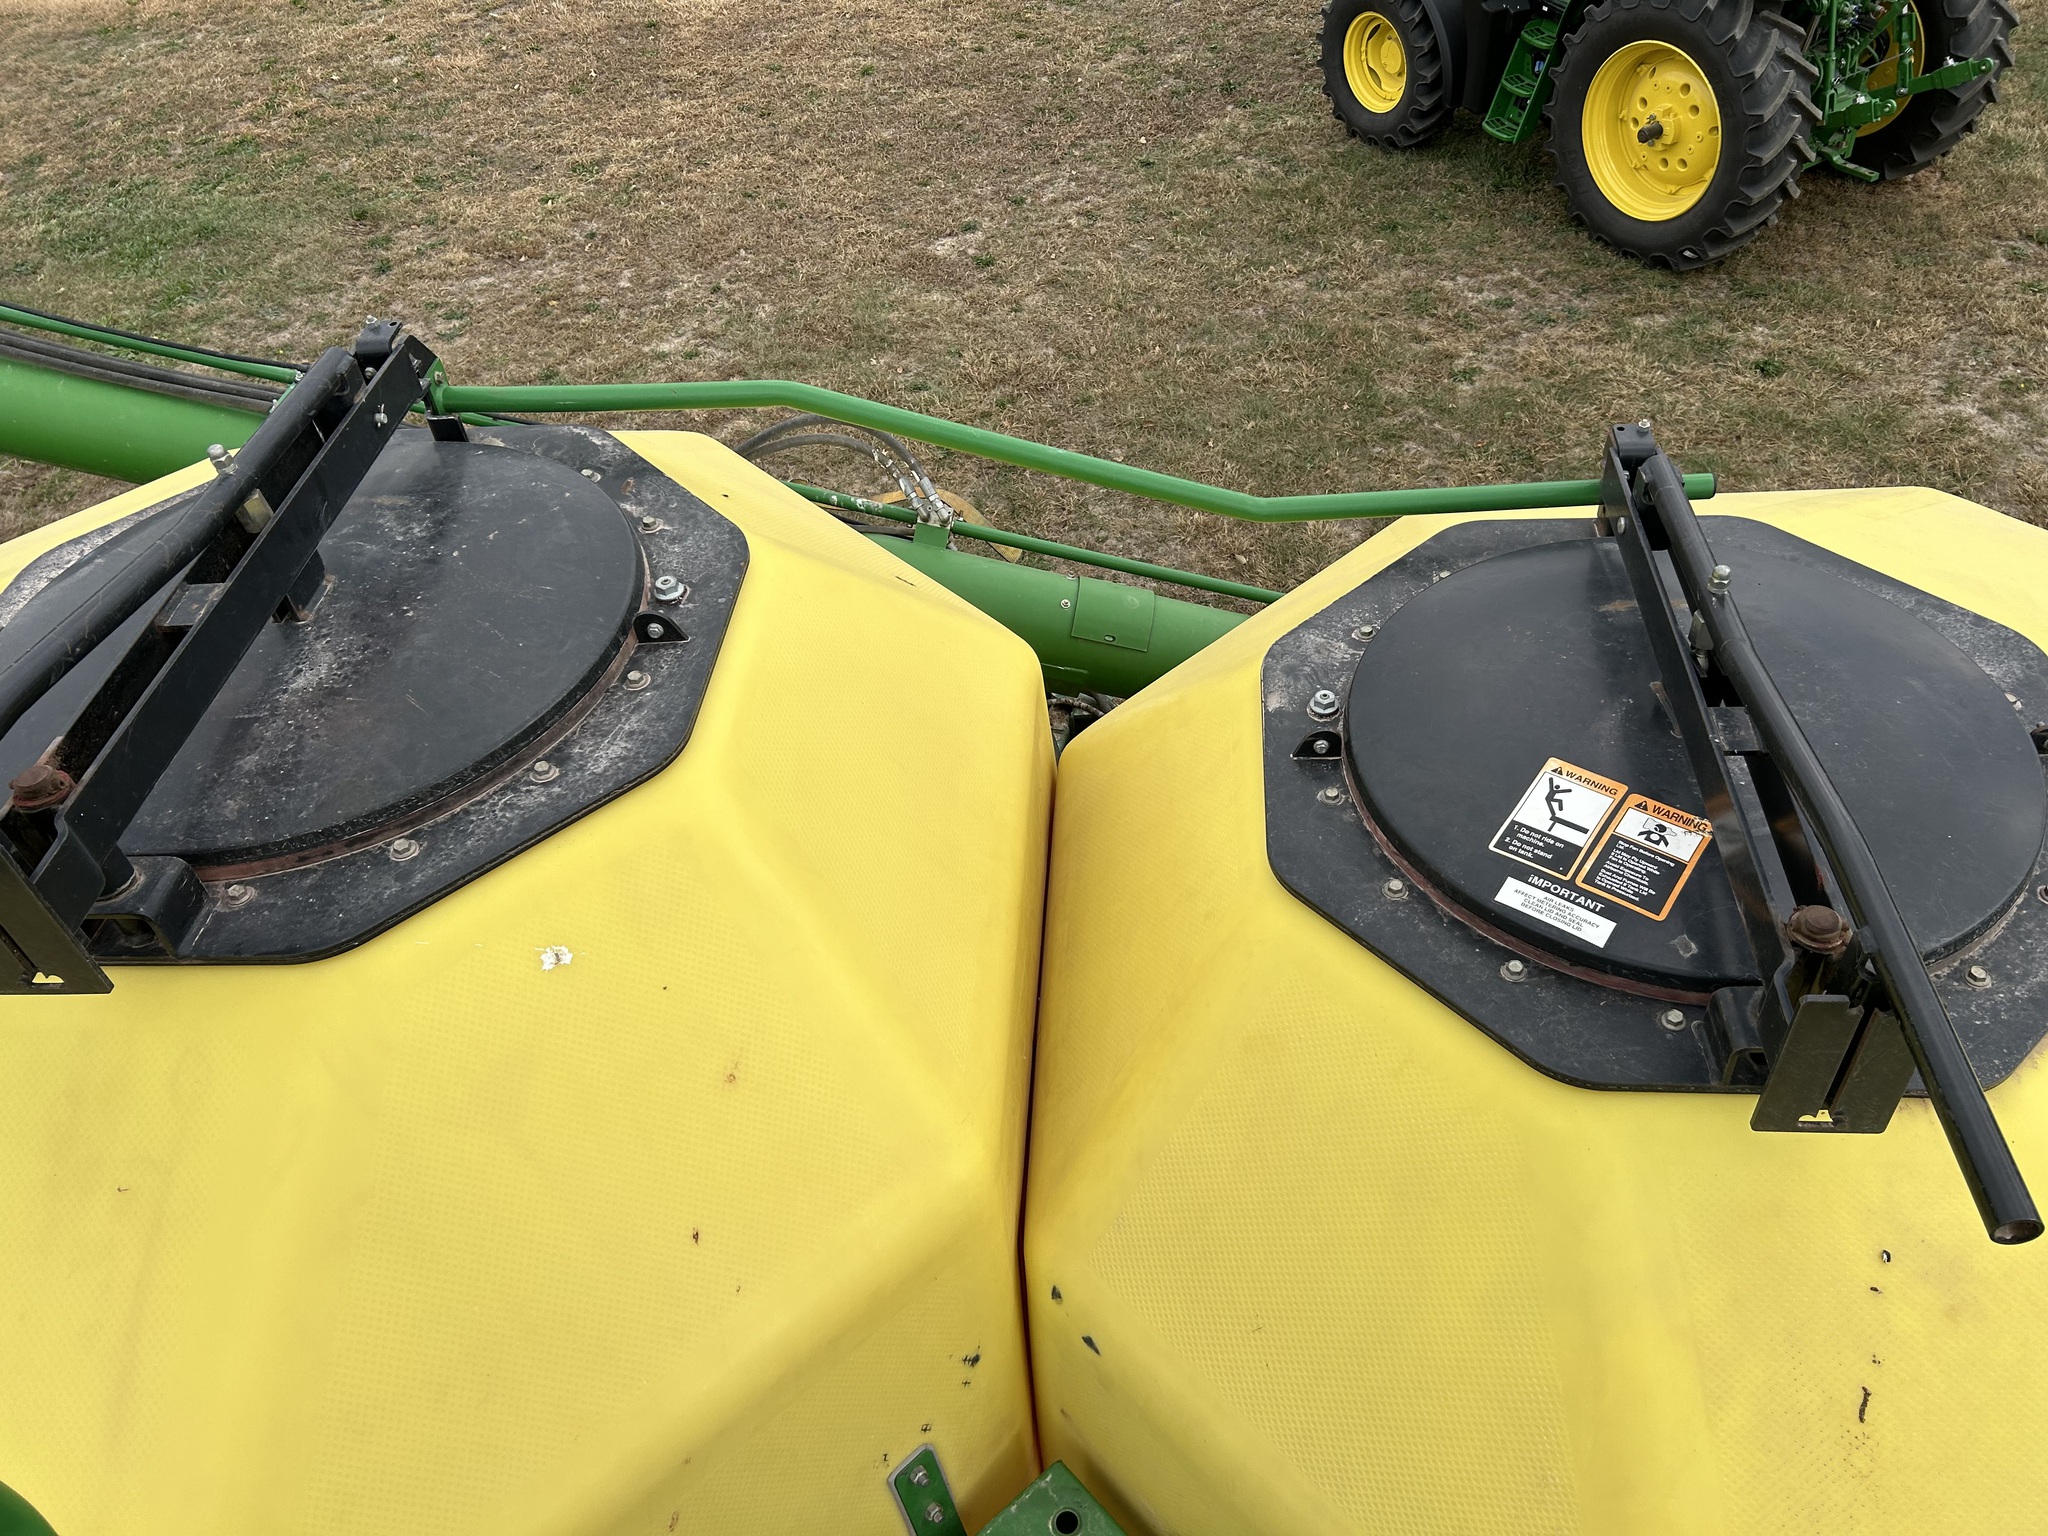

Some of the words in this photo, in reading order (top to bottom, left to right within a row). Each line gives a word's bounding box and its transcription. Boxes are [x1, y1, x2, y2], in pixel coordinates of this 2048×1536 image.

[1566, 770, 1618, 796] WARNING
[1653, 805, 1708, 831] WARNING
[1517, 833, 1544, 847] machine.
[1530, 831, 1541, 839] not
[1518, 849, 1533, 858] tank.
[1534, 849, 1552, 859] stand
[1514, 889, 1536, 900] AFFECT
[1536, 897, 1566, 913] METERING
[1567, 911, 1600, 928] ACCURACY
[1521, 903, 1544, 915] BEFORE
[1545, 913, 1571, 927] CLOSING
[1524, 899, 1543, 909] CLEAN
[1555, 911, 1567, 919] AND
[1568, 917, 1583, 927] SEAL
[1555, 900, 1574, 912] LEAKS
